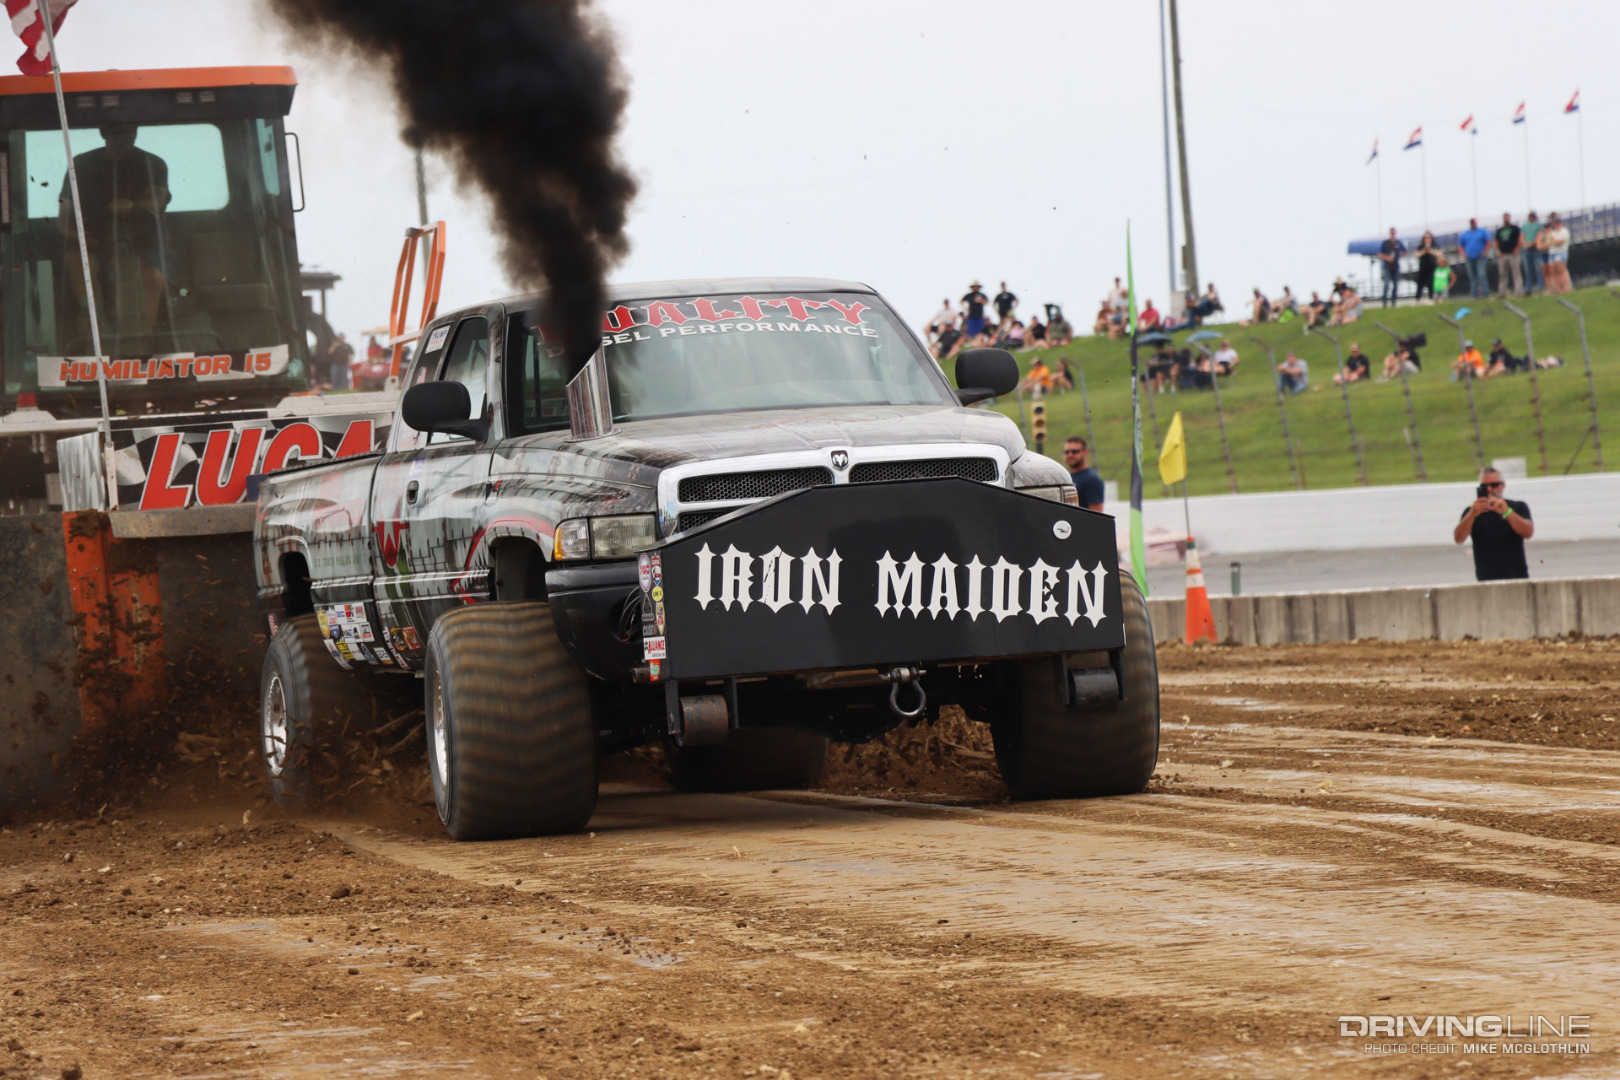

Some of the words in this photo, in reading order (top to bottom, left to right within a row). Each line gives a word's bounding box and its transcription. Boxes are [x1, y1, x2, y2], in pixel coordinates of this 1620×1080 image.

[660, 321, 879, 339] PERFORMANCE
[59, 355, 233, 382] HUMILIATOR
[244, 352, 272, 374] 15
[693, 541, 844, 616] IRON
[874, 549, 1109, 629] MAIDEN
